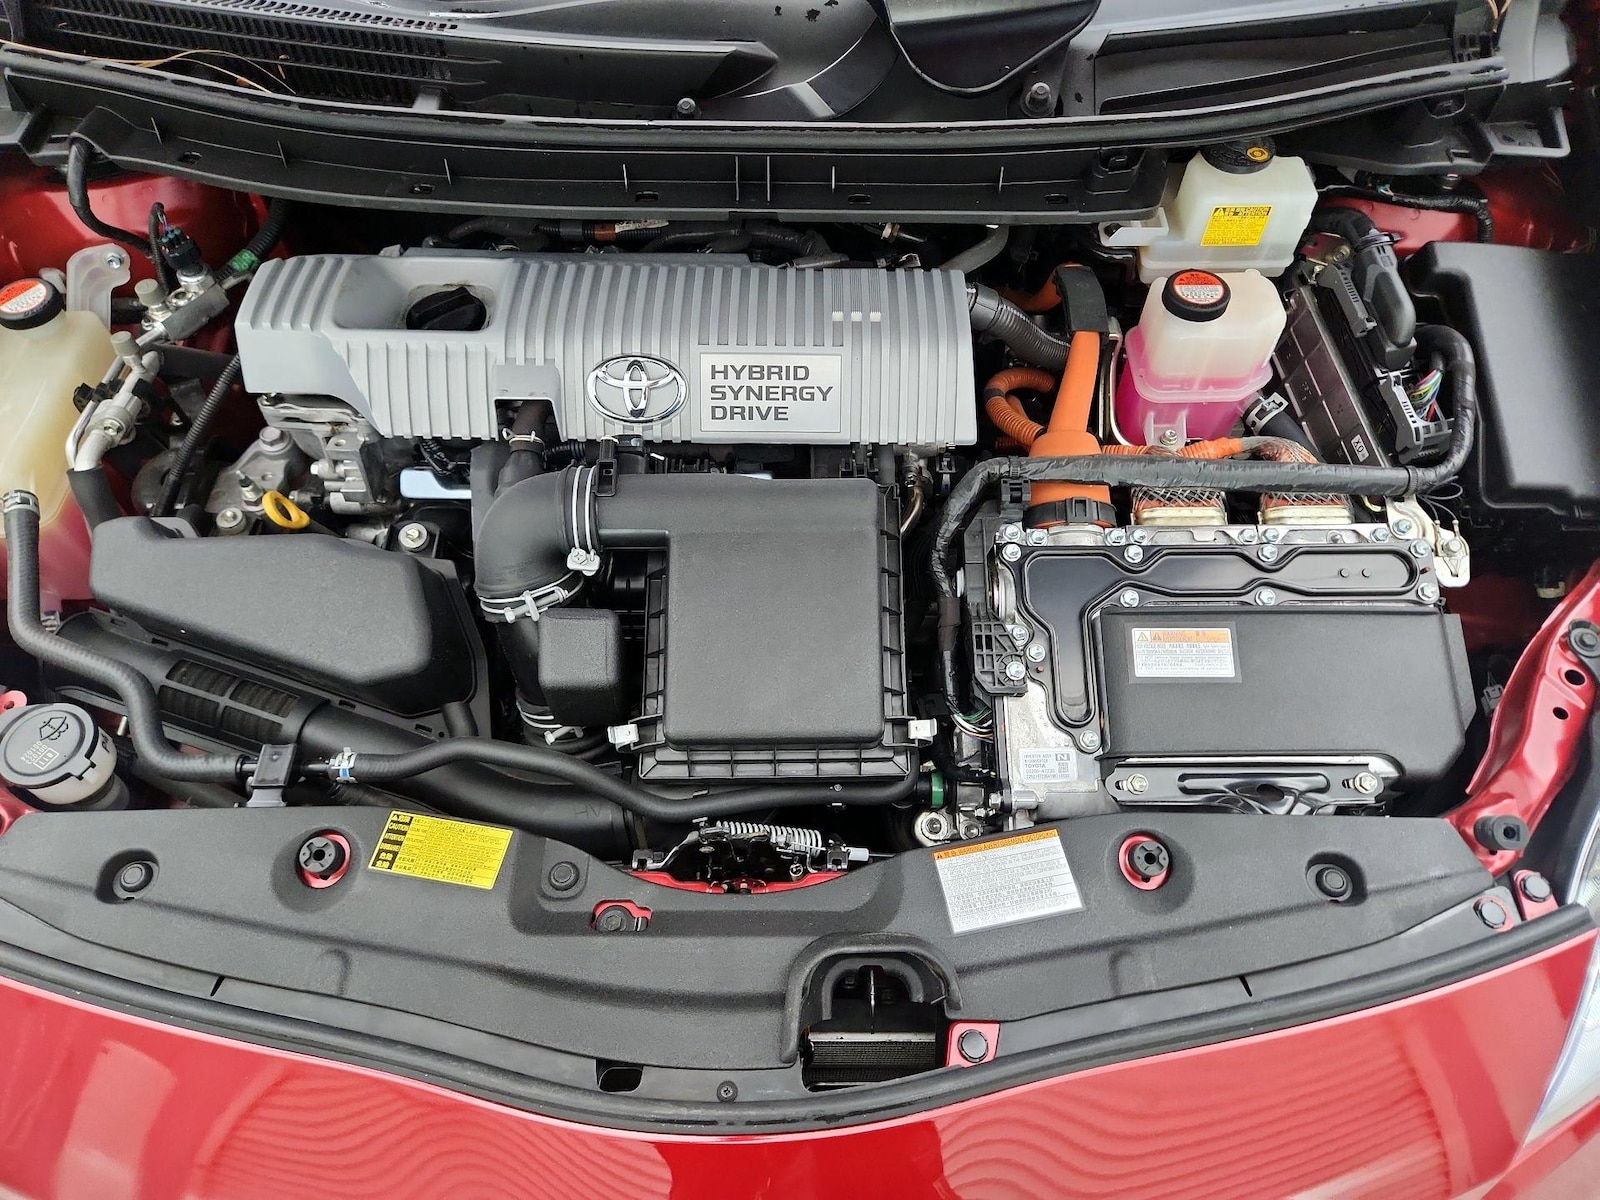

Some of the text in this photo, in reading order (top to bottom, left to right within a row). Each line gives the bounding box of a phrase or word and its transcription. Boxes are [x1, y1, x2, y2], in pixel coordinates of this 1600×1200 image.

[711, 364, 810, 381] HYBRID
[710, 385, 834, 402] SYNERGY
[711, 405, 789, 421] DRIVE
